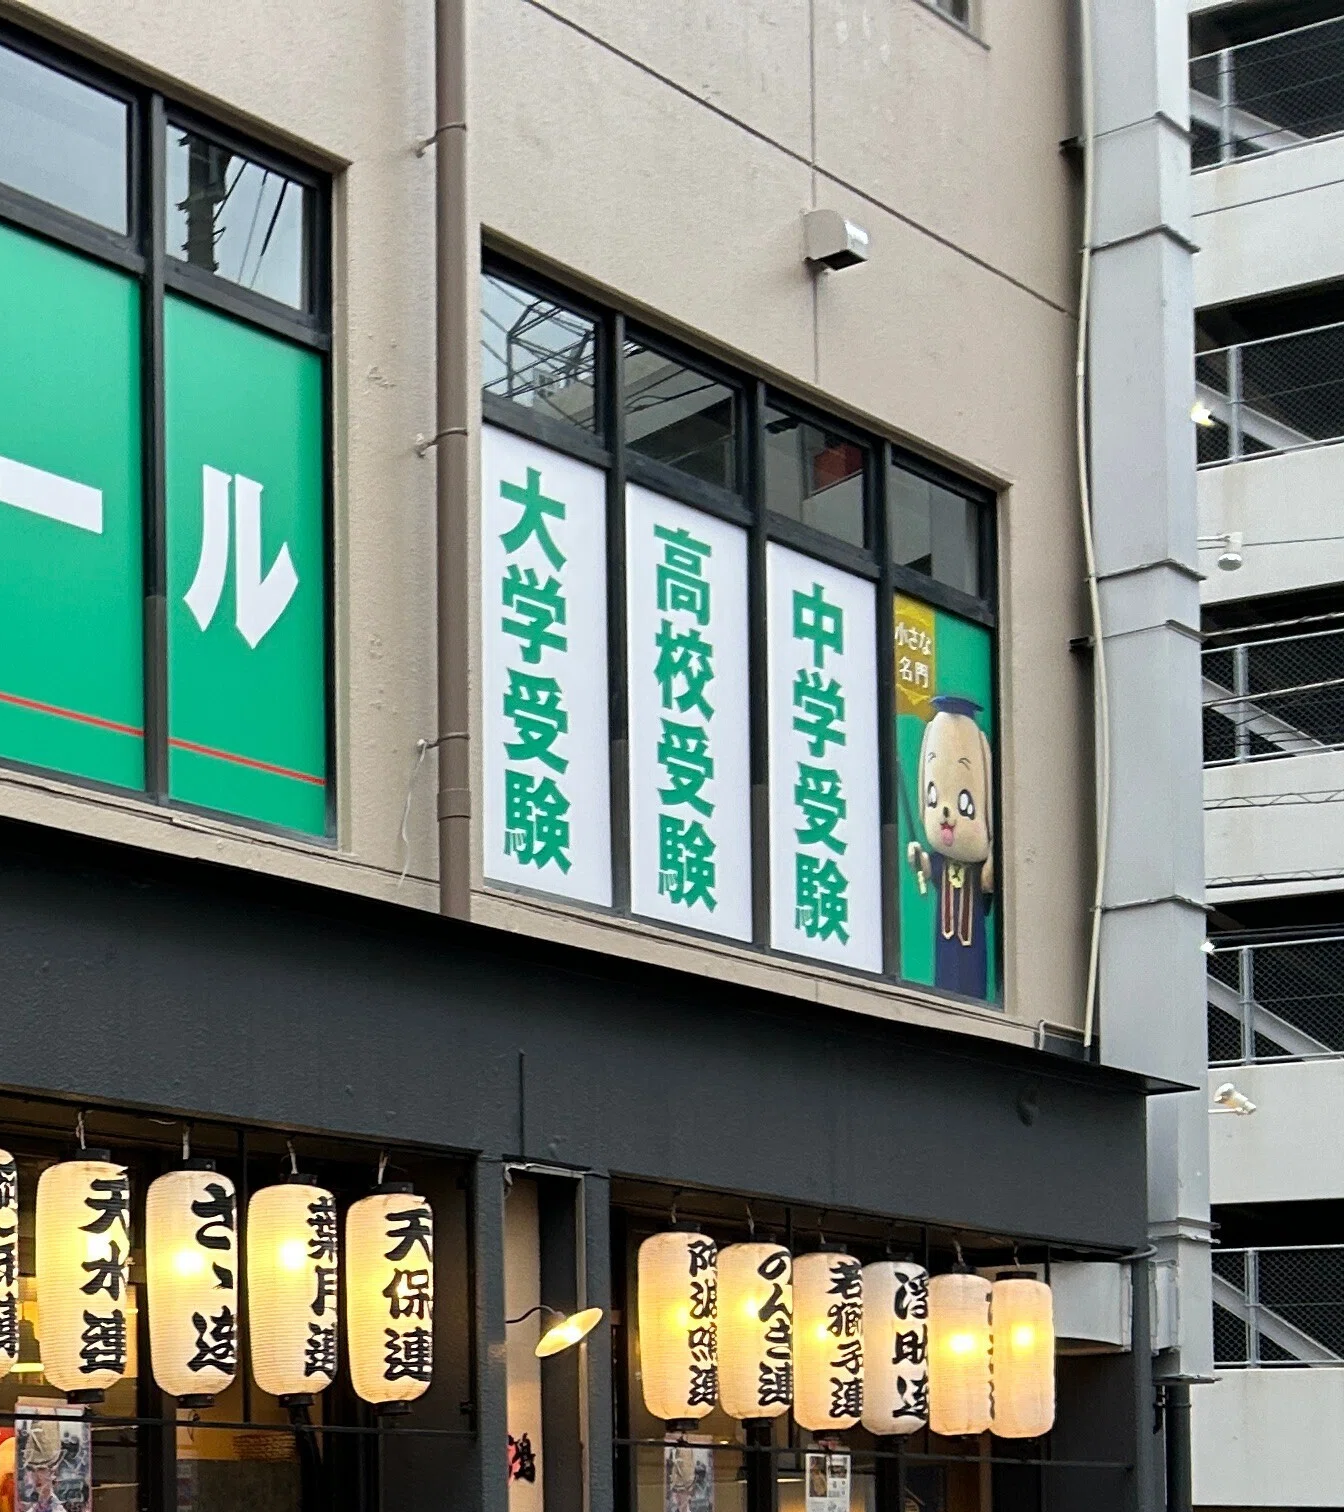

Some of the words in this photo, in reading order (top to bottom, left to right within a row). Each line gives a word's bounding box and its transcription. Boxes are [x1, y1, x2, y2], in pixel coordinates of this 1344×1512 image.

[499, 467, 573, 875] 大学受験
[653, 523, 718, 913] 高校受験
[792, 583, 851, 947] 中学受験
[894, 621, 932, 656] 小さな
[899, 656, 930, 689] 名門
[383, 1207, 433, 1382] 天保連
